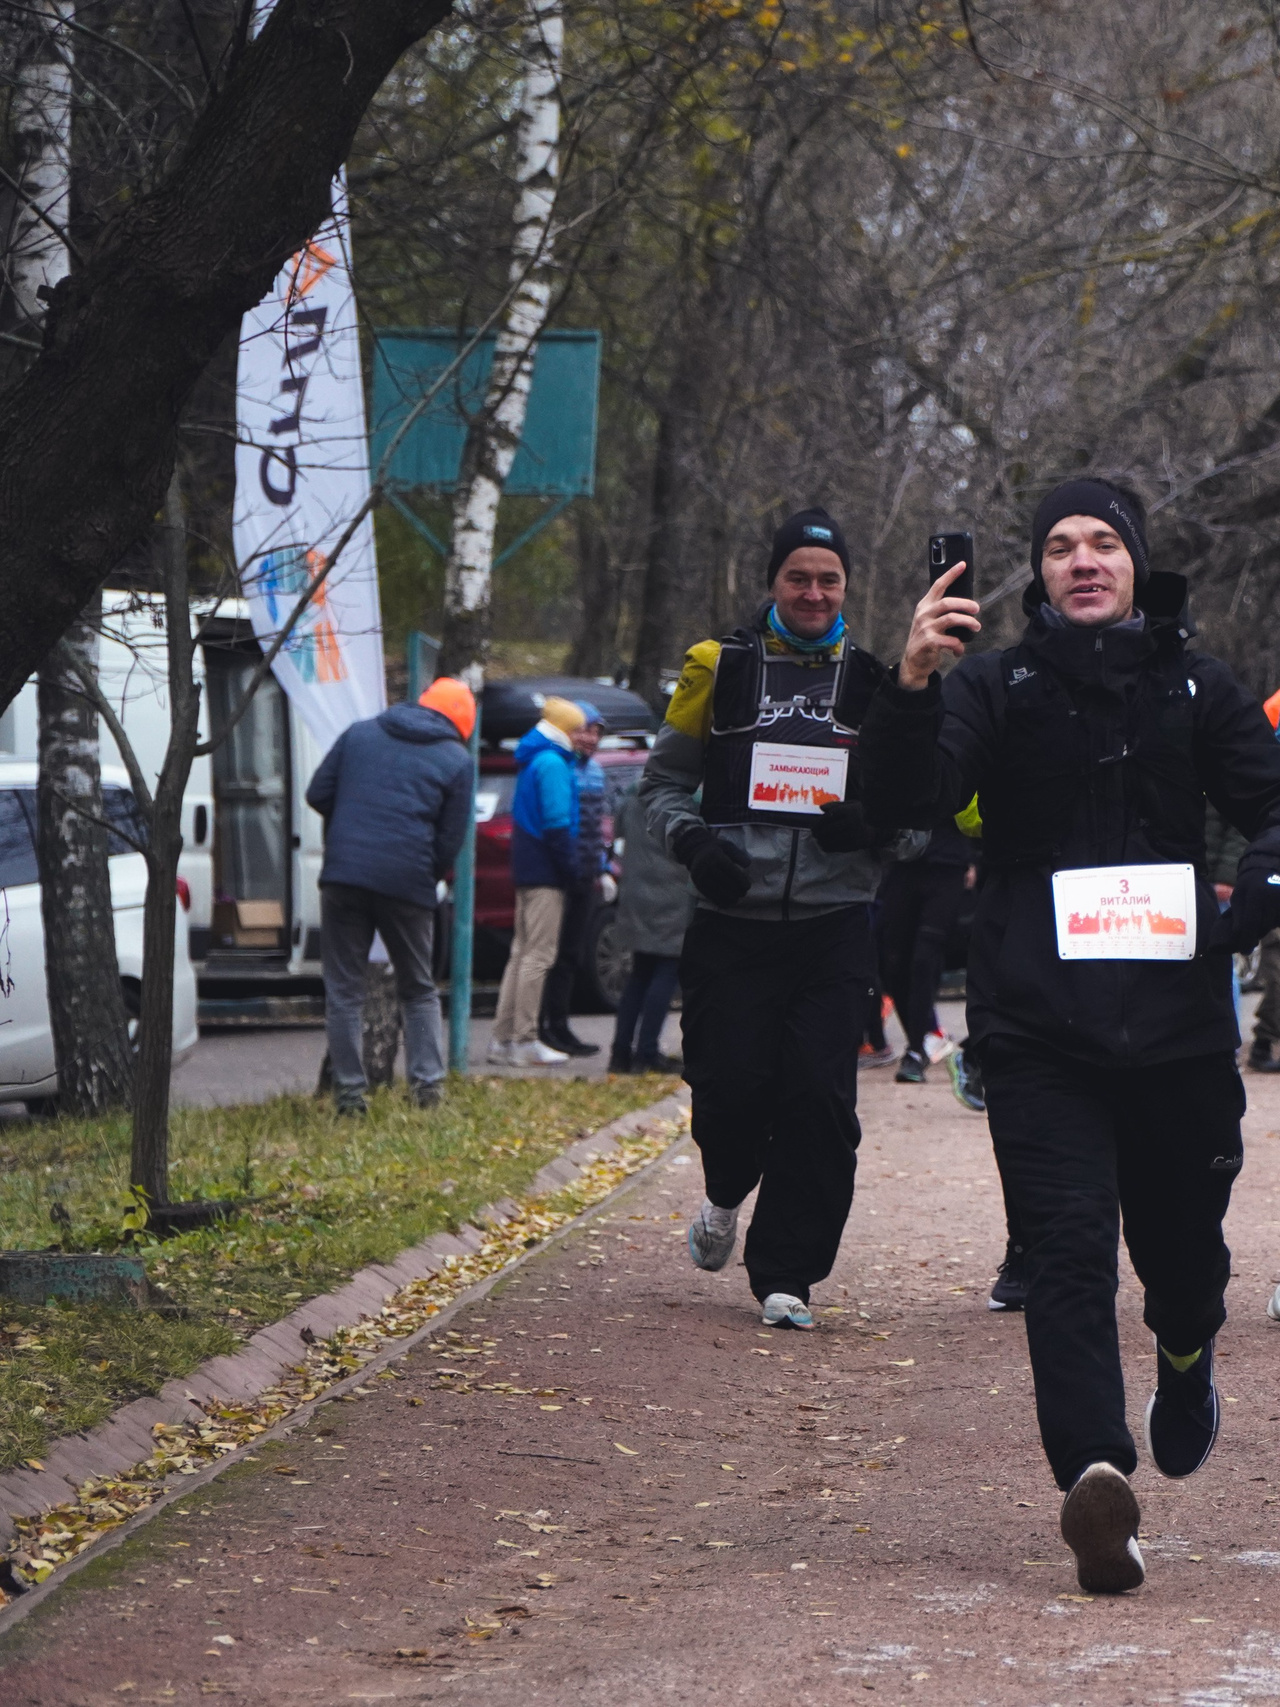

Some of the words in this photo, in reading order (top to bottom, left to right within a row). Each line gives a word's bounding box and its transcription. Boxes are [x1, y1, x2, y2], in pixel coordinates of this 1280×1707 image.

[769, 763, 830, 776] ЗАМЫКАЮЩИЙ
[1119, 879, 1130, 894] 3
[1100, 894, 1151, 906] ВИТАЛИЙ
